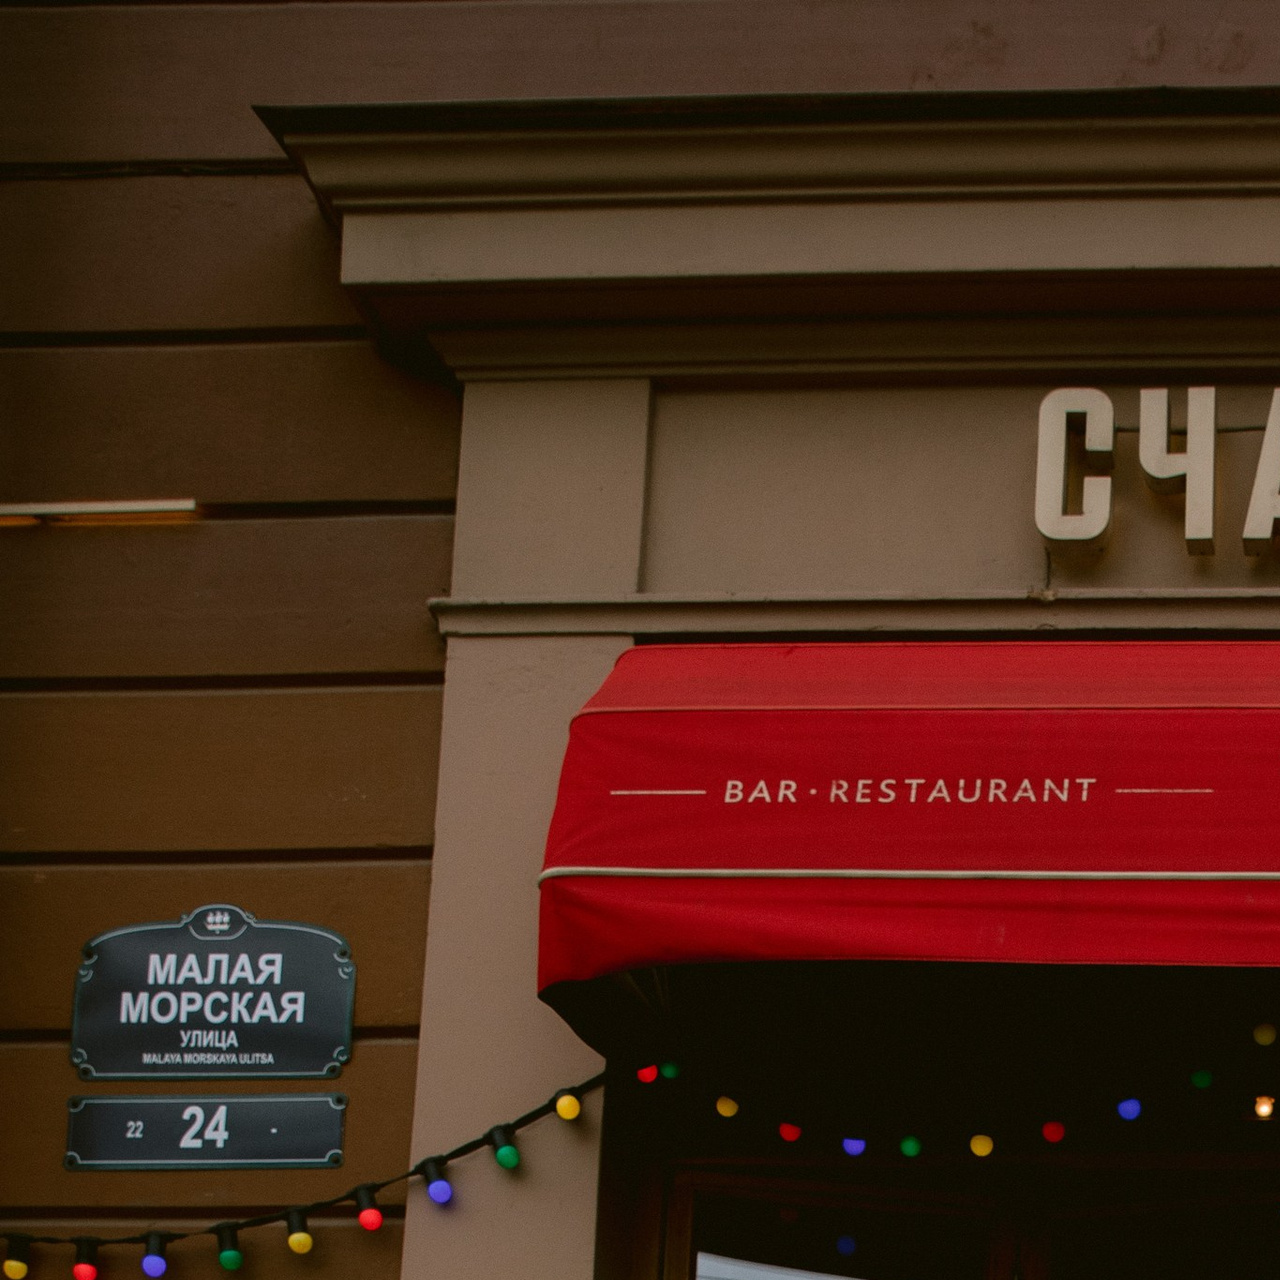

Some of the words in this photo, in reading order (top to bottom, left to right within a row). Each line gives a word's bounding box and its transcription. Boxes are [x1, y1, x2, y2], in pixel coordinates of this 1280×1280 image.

[723, 779, 797, 803] BAR
[829, 778, 1097, 804] RESTAURANT
[147, 953, 283, 985] МАЛАЯ
[119, 991, 306, 1024] МОРСКАЯ
[179, 1030, 239, 1051] УЛИЦА
[142, 1053, 182, 1064] MALAYA
[183, 1053, 238, 1064] MORSKAYA
[239, 1053, 274, 1064] ULITSA
[125, 1121, 144, 1139] 22
[179, 1105, 229, 1149] 24
